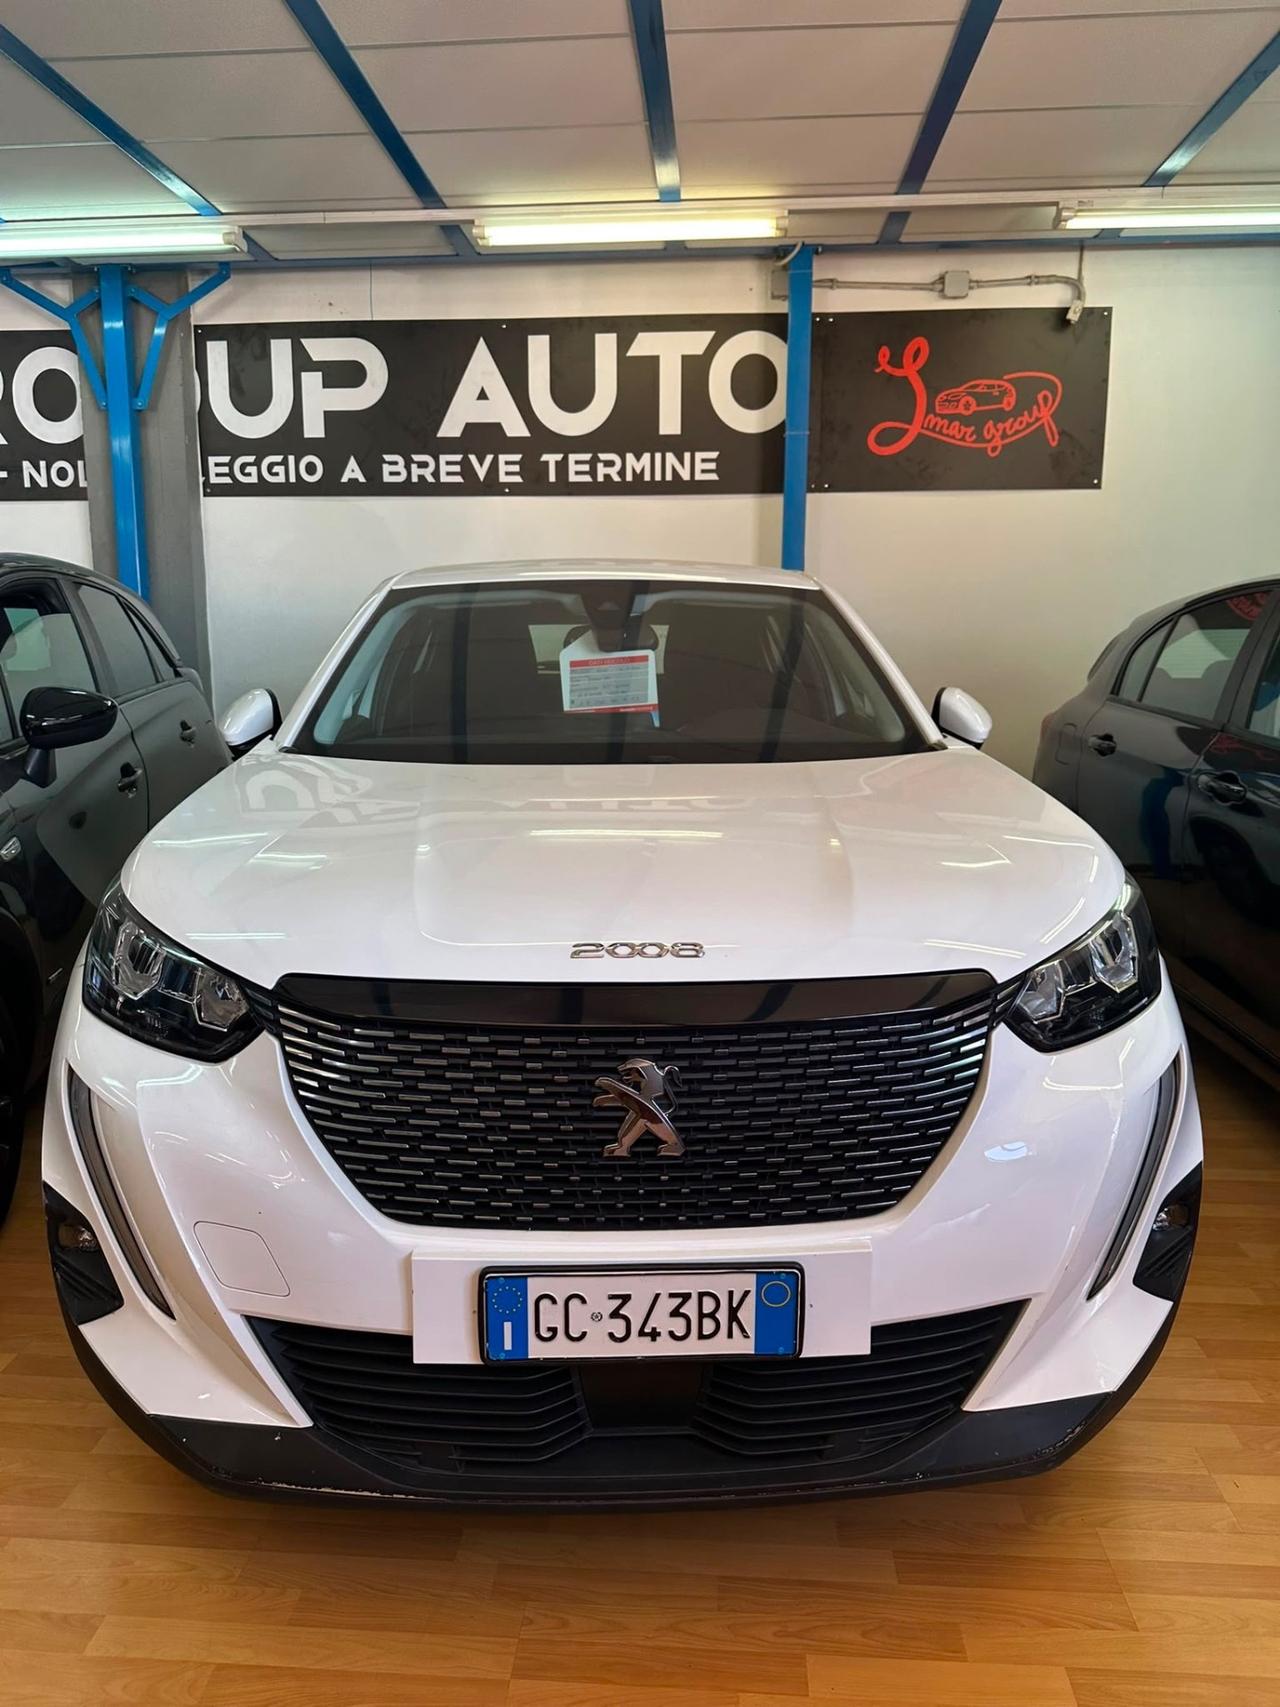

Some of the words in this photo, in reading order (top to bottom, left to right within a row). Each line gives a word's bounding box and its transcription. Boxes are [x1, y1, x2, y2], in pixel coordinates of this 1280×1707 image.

[436, 330, 789, 438] AUTO
[340, 455, 367, 483] A
[382, 453, 524, 483] BREVE
[540, 451, 720, 483] TERMINE
[570, 942, 706, 959] 2008
